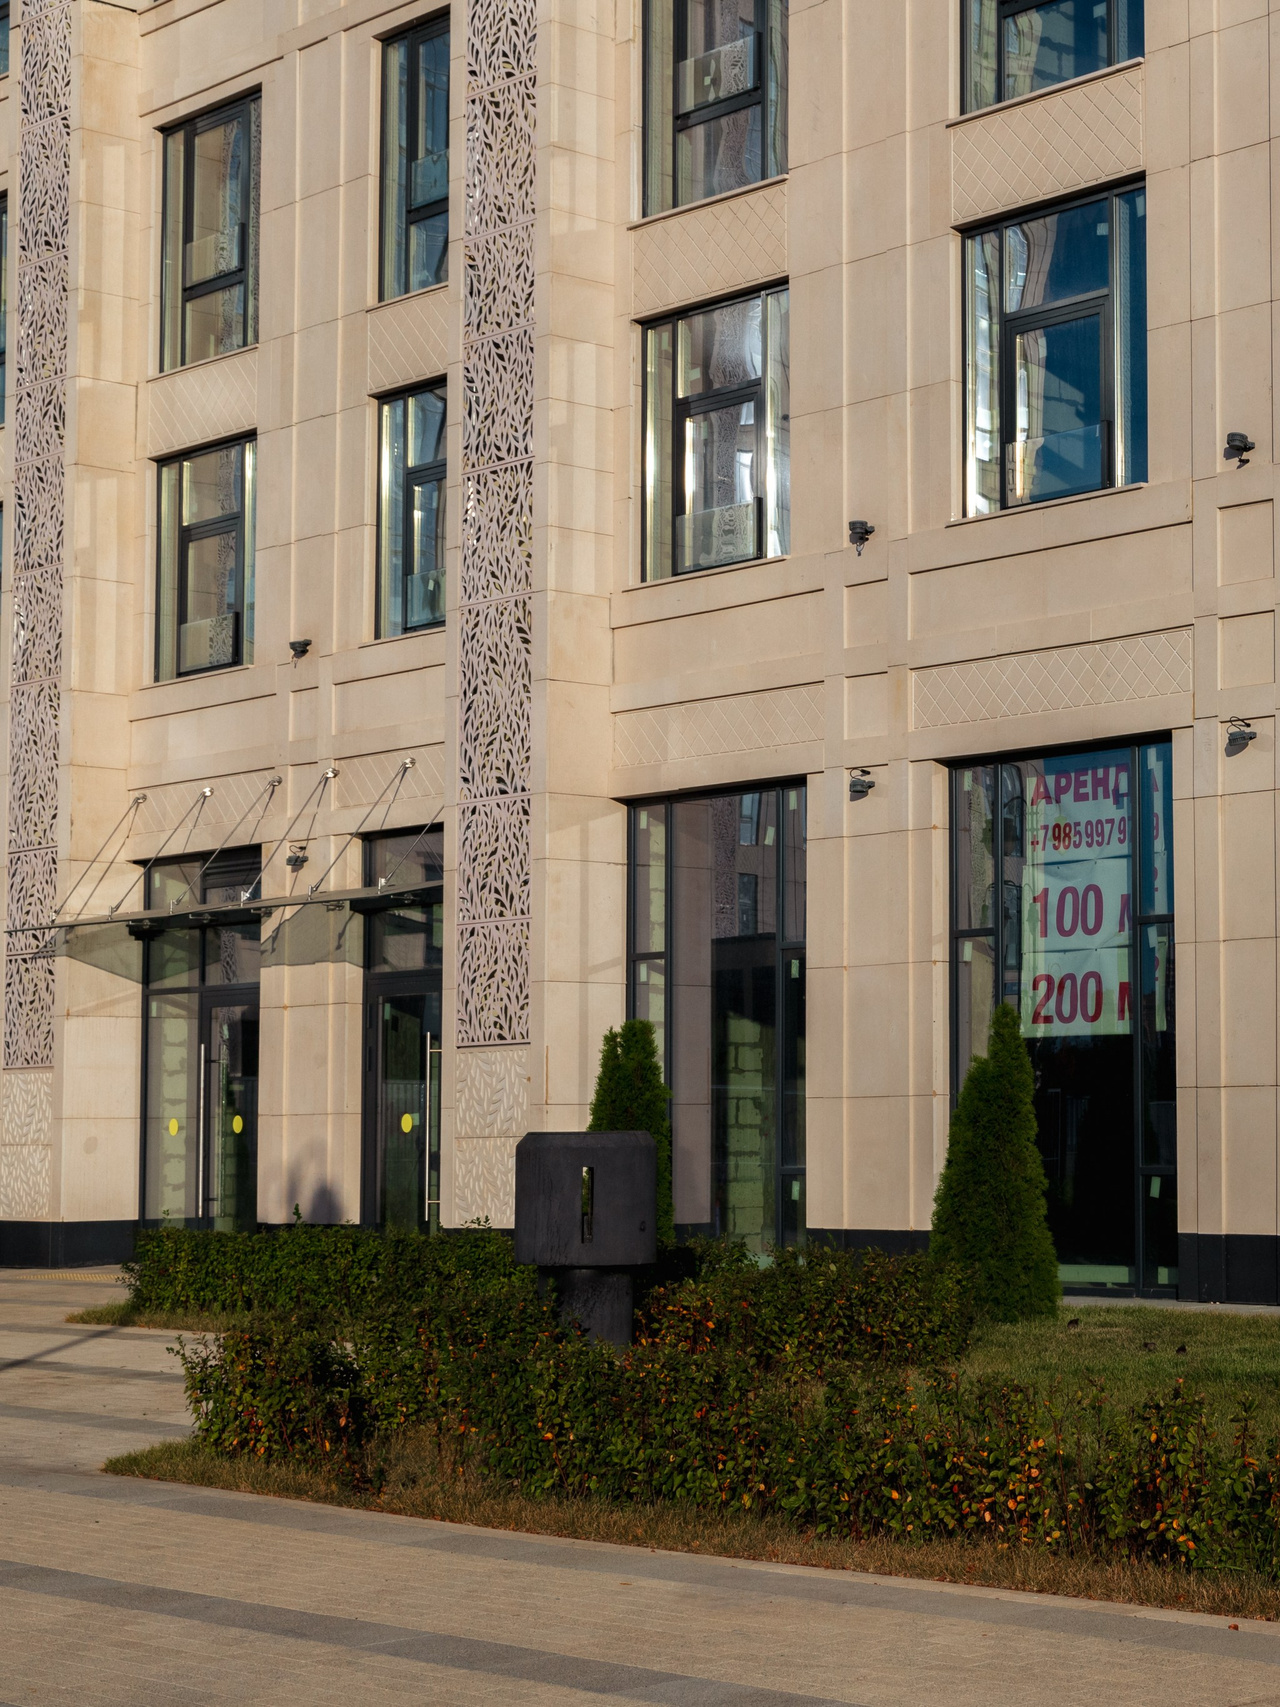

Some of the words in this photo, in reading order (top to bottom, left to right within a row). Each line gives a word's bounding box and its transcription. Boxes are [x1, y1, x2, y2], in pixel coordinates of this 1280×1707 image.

[1031, 763, 1158, 806] АРЕНД
[1033, 884, 1103, 938] 100
[1031, 971, 1103, 1024] 200
